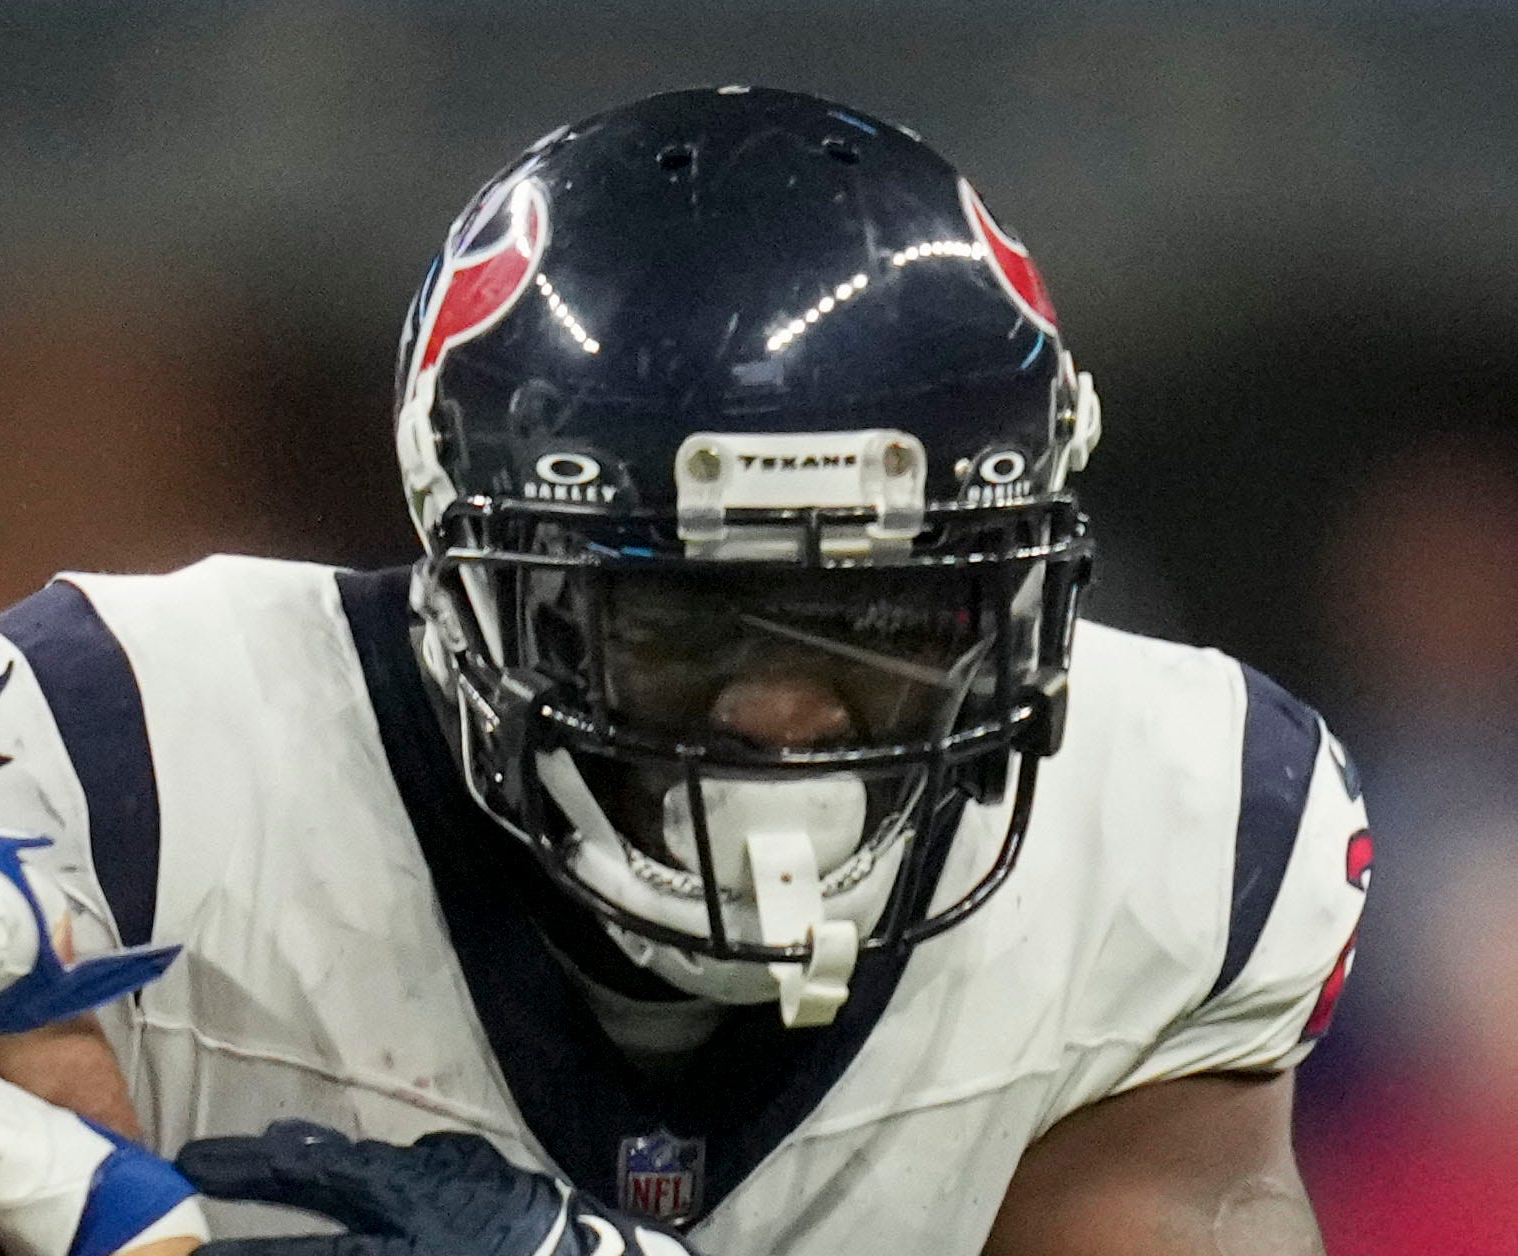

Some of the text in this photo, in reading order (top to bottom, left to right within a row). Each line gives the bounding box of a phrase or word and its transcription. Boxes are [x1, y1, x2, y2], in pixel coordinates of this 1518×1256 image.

[737, 454, 857, 470] TEXANS
[524, 481, 617, 503] OAKLEY
[633, 1176, 688, 1213] NFL
